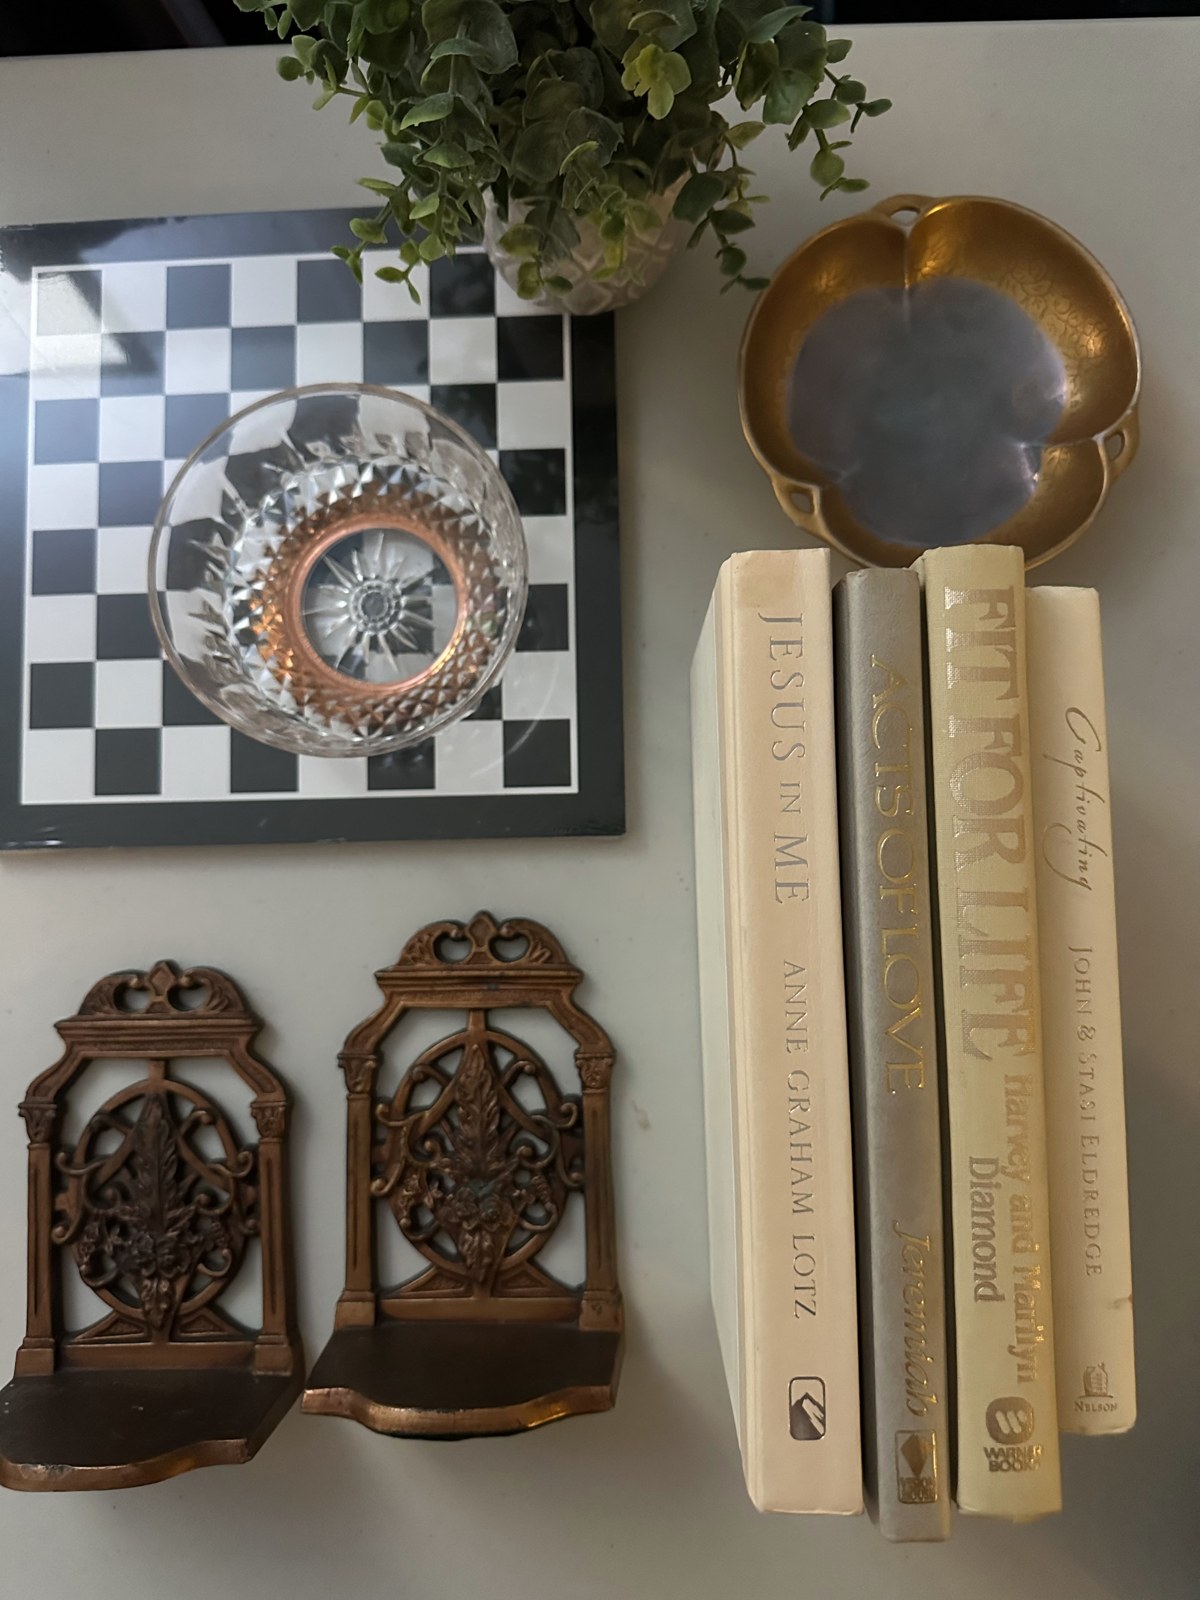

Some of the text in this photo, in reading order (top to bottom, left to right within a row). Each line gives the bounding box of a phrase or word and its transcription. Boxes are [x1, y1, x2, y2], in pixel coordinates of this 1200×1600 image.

[758, 611, 809, 904] JESUS IN ME
[869, 654, 926, 1095] ACTS OF LOVE
[944, 585, 1037, 1063] FIT FOR LIFE
[783, 959, 817, 1320] ANNE GRAHAM LOTZ
[967, 1155, 1005, 1304] Diamond
[1008, 1192, 1041, 1256] and
[1067, 945, 1102, 1276] JOHN & STASI ELDREDGE
[891, 1219, 938, 1417] Jeremiah
[983, 1446, 1043, 1459] WARNER
